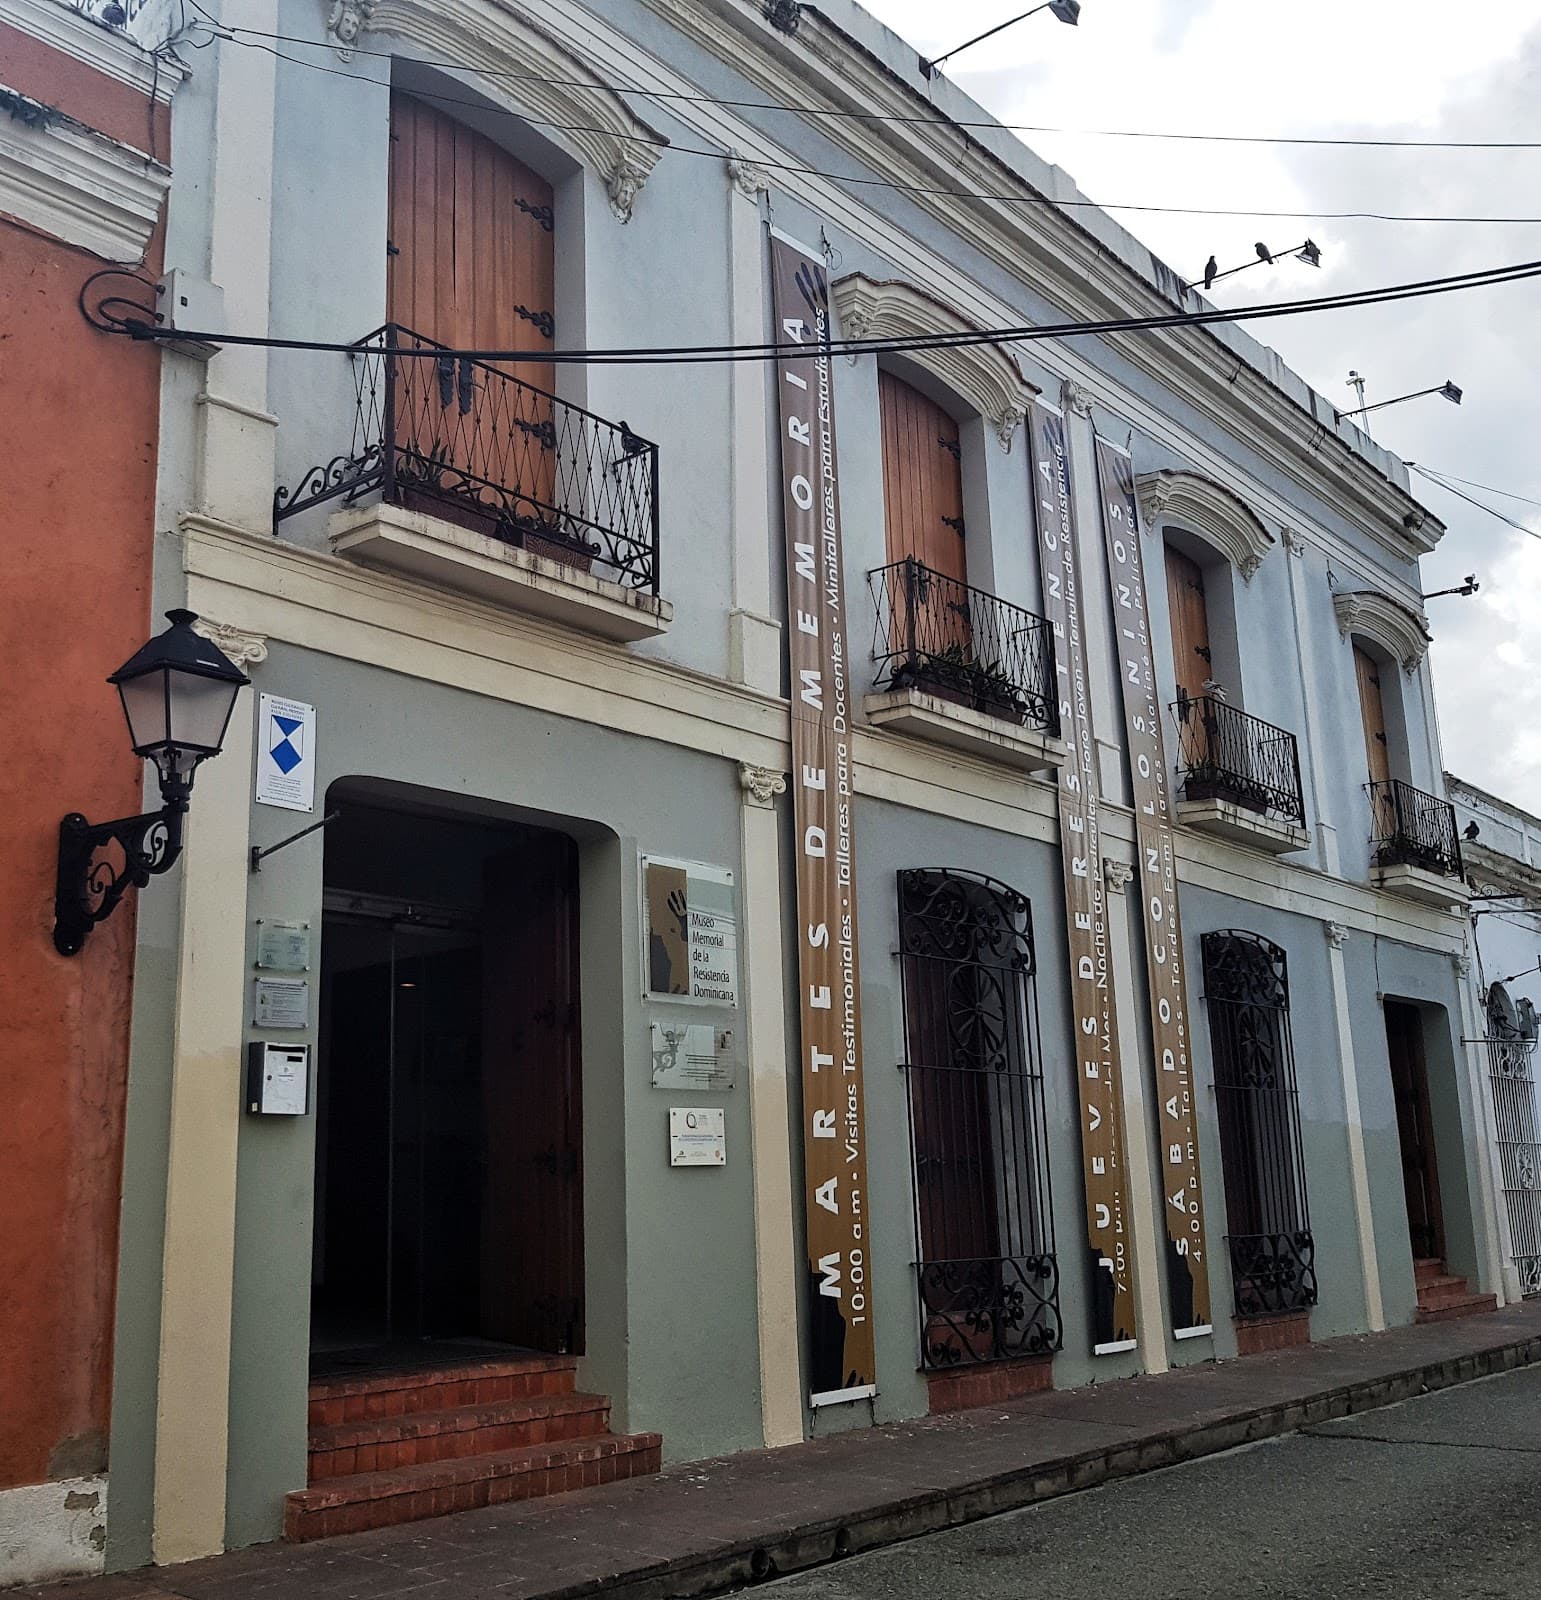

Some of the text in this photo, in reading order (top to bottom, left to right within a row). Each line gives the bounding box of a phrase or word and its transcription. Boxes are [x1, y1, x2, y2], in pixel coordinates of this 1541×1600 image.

[820, 431, 836, 481] para
[1054, 444, 1070, 545] Resistencia
[822, 486, 839, 609] Minitalleres
[1062, 551, 1073, 574] de
[1126, 505, 1143, 610] Películas
[1065, 581, 1079, 648] Tertulia
[1137, 620, 1148, 646] de
[831, 632, 846, 734] Docentes
[1074, 668, 1086, 722] Joven
[1141, 655, 1158, 738] Matiné
[836, 743, 851, 796] para
[1080, 730, 1092, 773] Foro
[783, 318, 841, 1298] MARTES DE MEMORIA
[1154, 760, 1173, 893] Familiares
[836, 804, 850, 888] Talleres
[1039, 461, 1114, 1274] JUEVES DE RESISTENCIA
[1110, 502, 1188, 1257] SÁBADO CON LOS NIÑOS
[692, 912, 714, 928] Museo
[692, 930, 724, 946] Memorial
[1167, 904, 1180, 987] Tardes
[693, 948, 709, 963] de la
[693, 965, 730, 983] Resistencia
[1094, 922, 1108, 988] Noche
[694, 983, 734, 1001] Dominicana
[839, 915, 856, 1075] Testimoniales
[1175, 1011, 1190, 1116] Talleres
[844, 1083, 858, 1163] Visitas
[851, 1190, 861, 1240] a.m
[1189, 1201, 1202, 1263] 4:00
[850, 1249, 865, 1326] 10:00
[1115, 1242, 1127, 1294] 7:00
